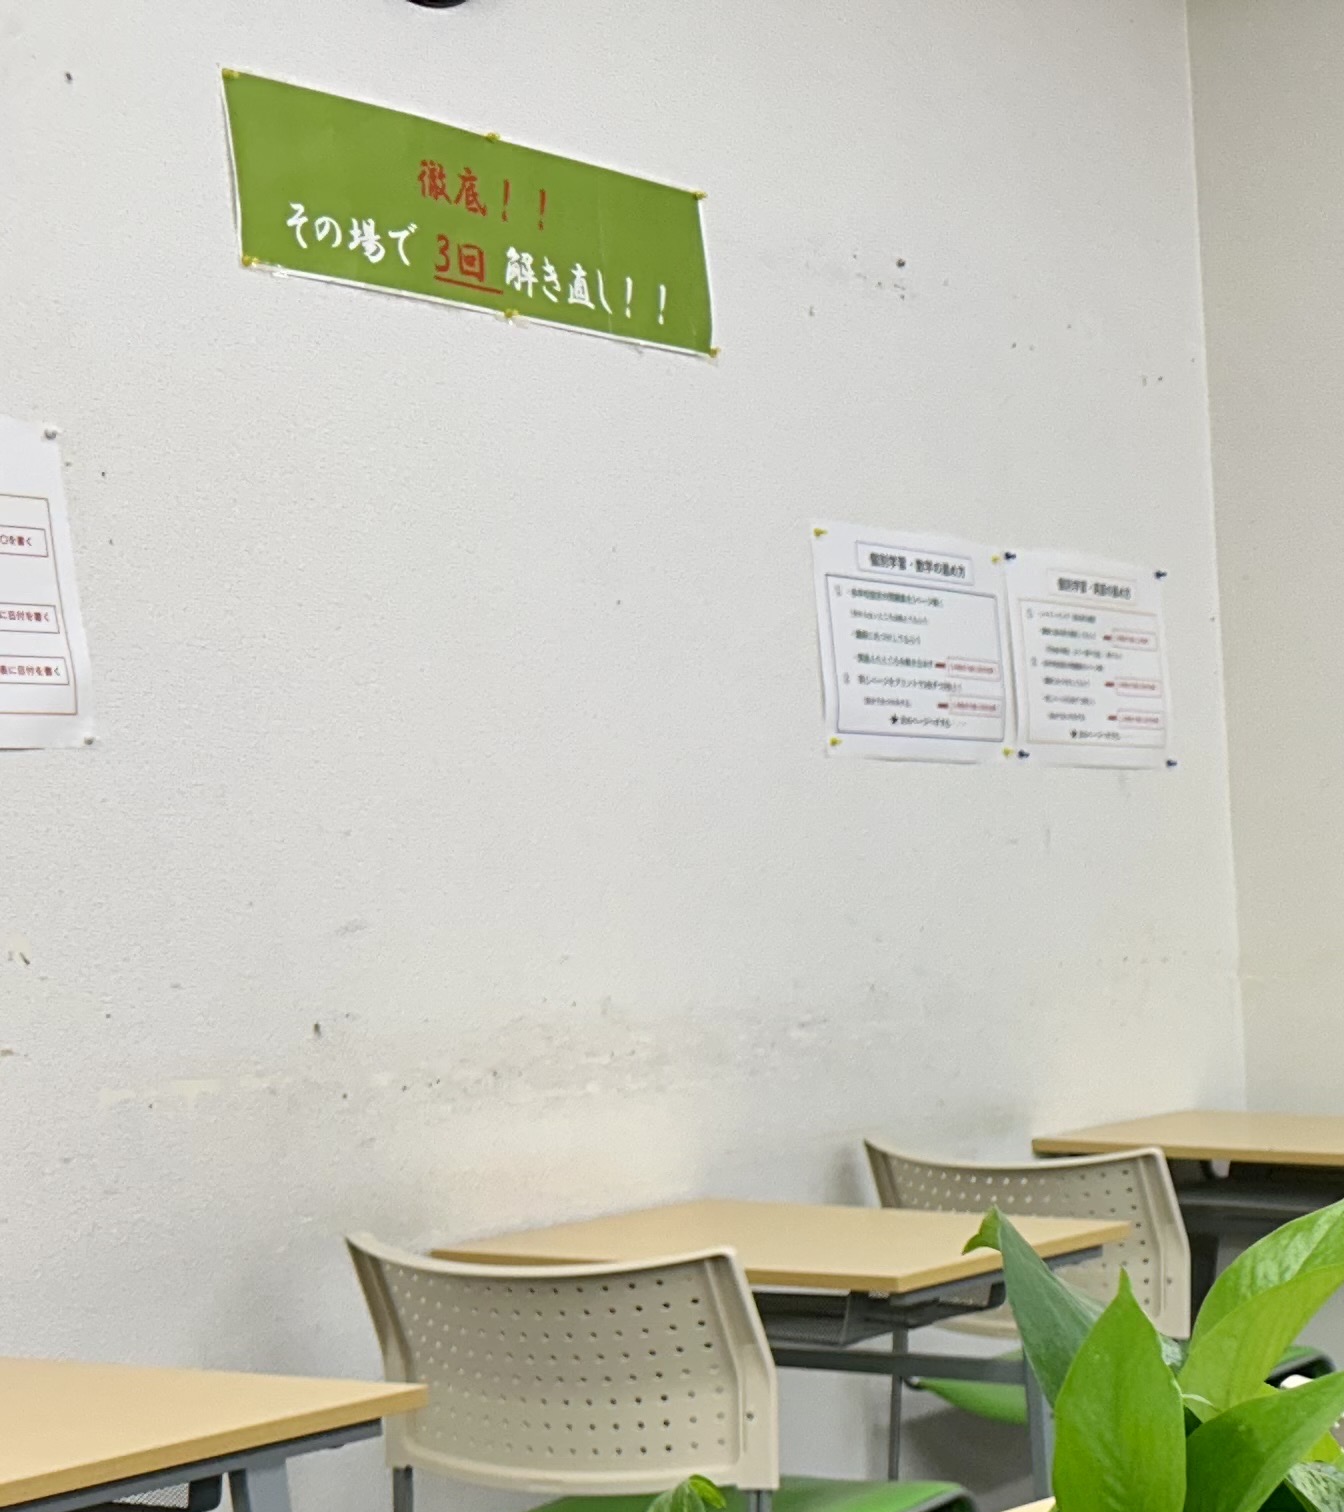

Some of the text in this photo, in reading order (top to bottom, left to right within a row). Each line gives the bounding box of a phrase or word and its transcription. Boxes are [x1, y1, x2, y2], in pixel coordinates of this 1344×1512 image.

[416, 159, 547, 232] 徹底！！
[285, 202, 667, 326] その場で 3回 解き直し！！
